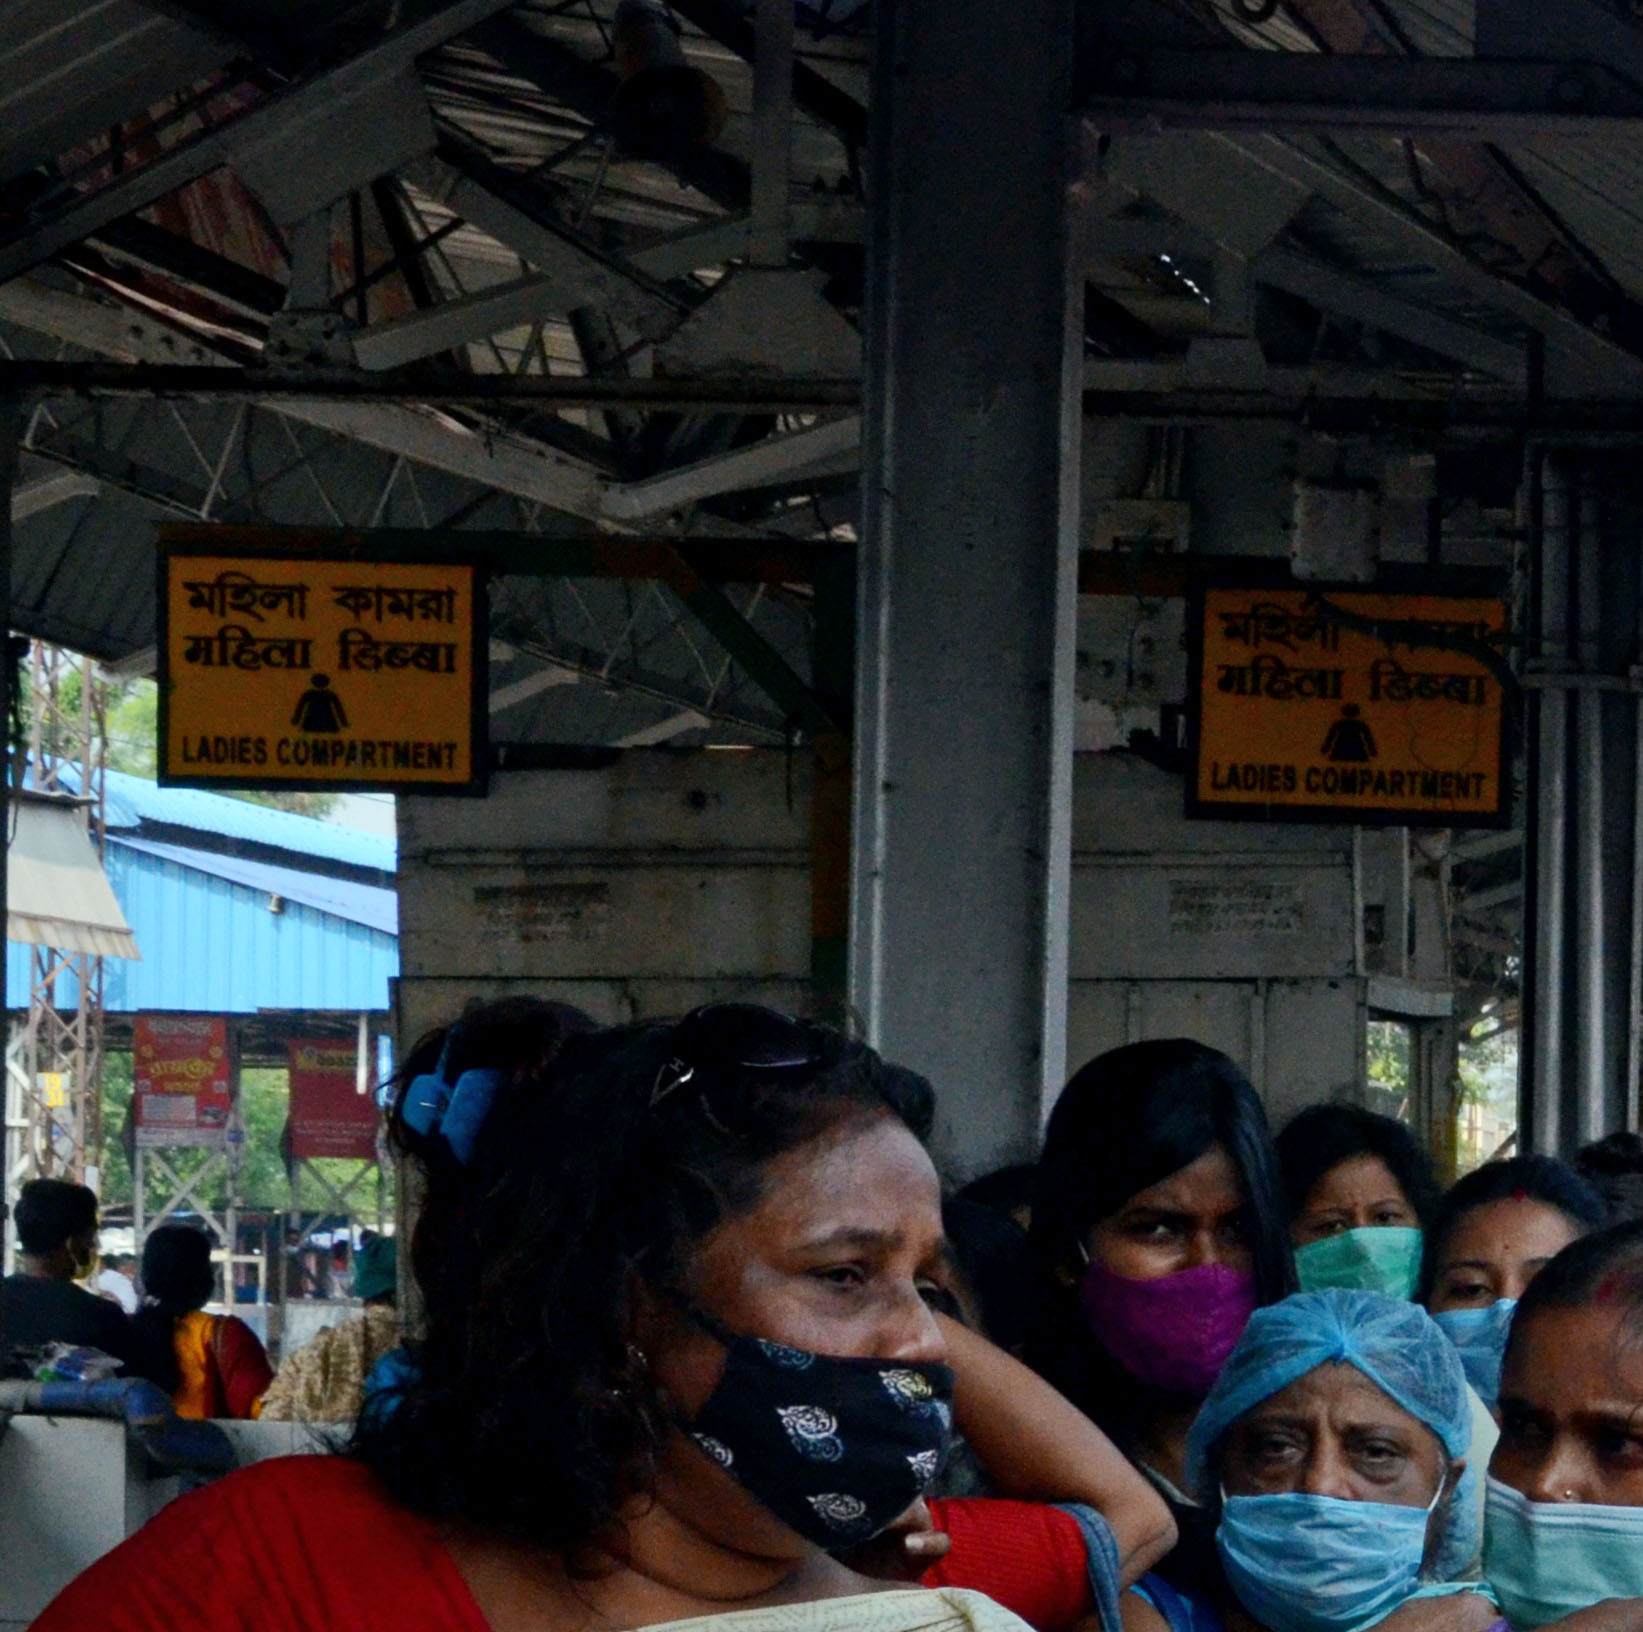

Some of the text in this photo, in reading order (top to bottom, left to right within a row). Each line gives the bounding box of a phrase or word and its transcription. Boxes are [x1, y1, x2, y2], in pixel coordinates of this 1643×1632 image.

[182, 571, 458, 624] মহিলা কামরা
[183, 624, 458, 673] महिला डिब्बा
[1216, 655, 1488, 705] महिला डिब्बा
[182, 735, 458, 769] LADIES COMPARTMENT
[1211, 761, 1487, 799] LADIES COMPARTMENT
